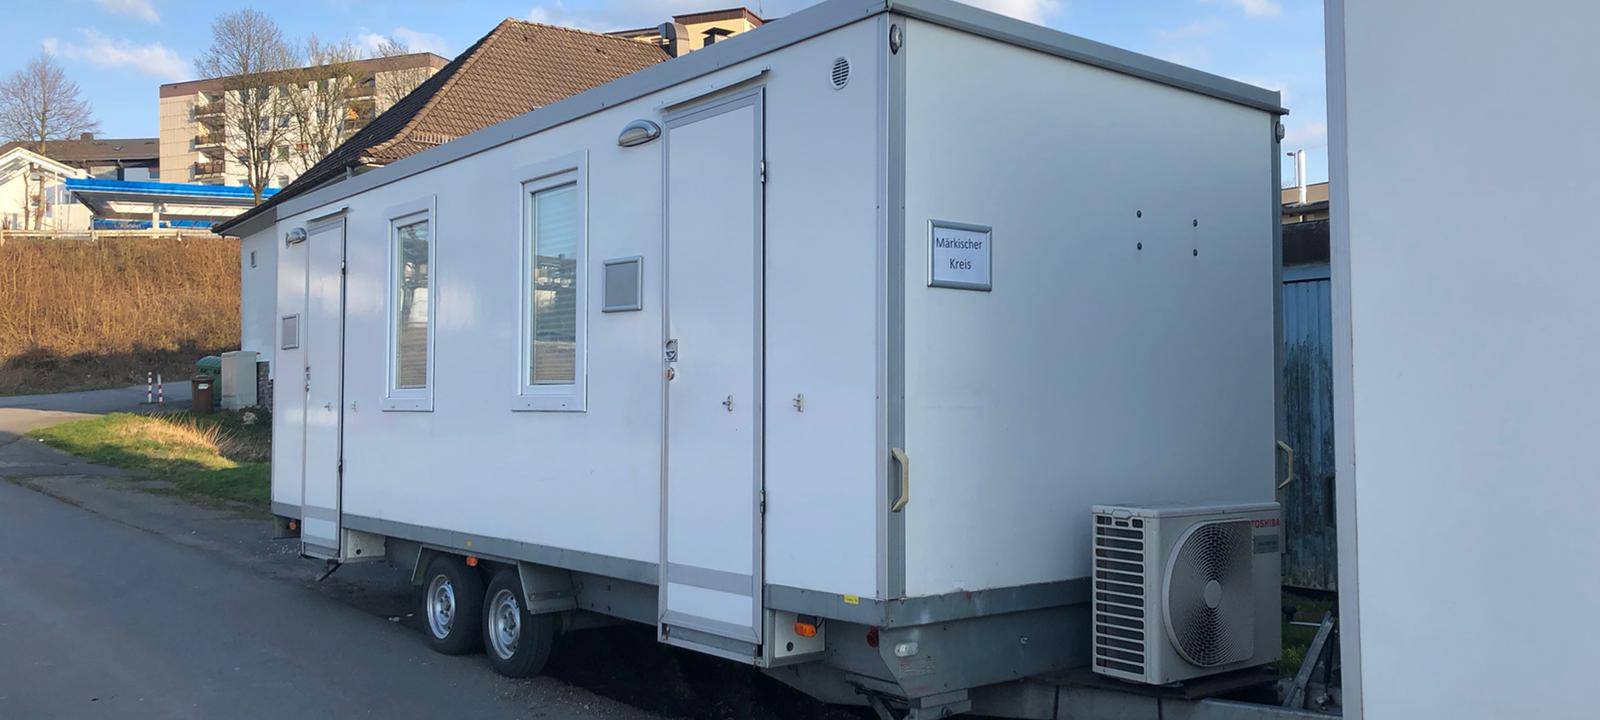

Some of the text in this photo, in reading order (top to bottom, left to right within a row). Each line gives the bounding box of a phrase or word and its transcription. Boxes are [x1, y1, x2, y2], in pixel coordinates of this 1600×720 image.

[935, 237, 982, 249] Märkischer
[949, 258, 972, 270] Kreis
[1251, 518, 1280, 528] TOSHIBA
